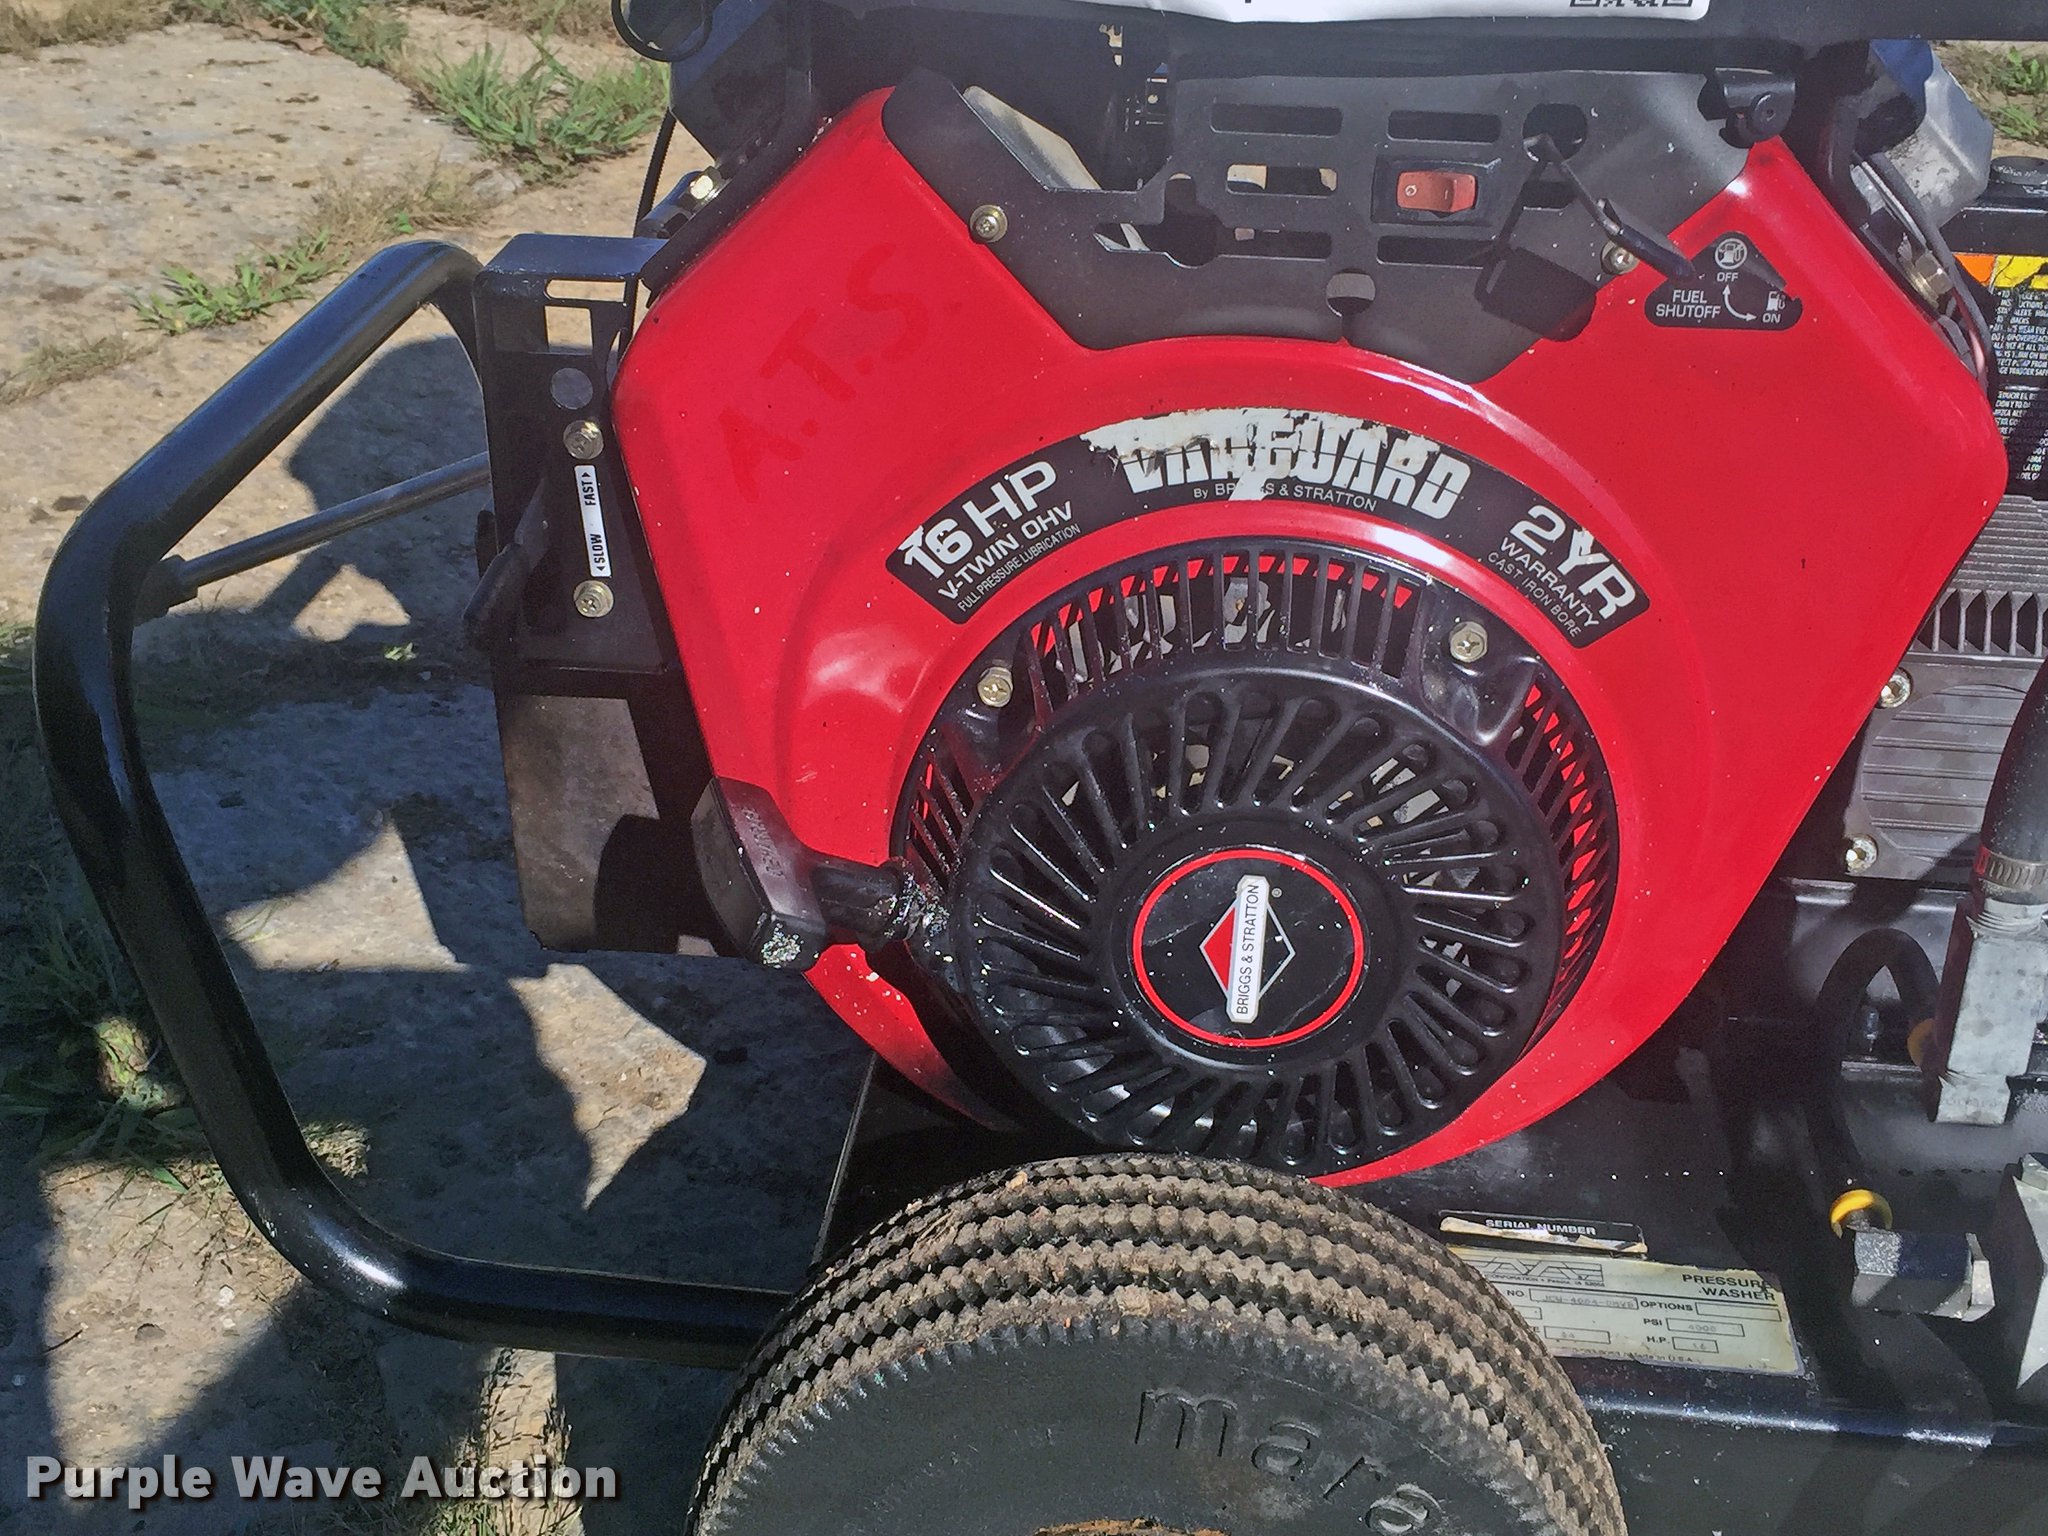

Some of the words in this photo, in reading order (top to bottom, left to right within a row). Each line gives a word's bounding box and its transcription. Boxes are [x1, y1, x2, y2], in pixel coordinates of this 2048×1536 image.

[1716, 272, 1739, 282] OFF
[1672, 289, 1708, 304] FUEL
[1655, 304, 1721, 319] SHUTOFF
[1762, 312, 1781, 323] ON
[581, 480, 597, 506] FAST
[1193, 488, 1208, 499] By
[1278, 484, 1289, 496] &
[1293, 485, 1377, 512] STRATTON
[903, 518, 974, 579] 16
[962, 461, 1057, 539] HP
[590, 533, 606, 564] SLOW
[937, 532, 1020, 600] V-TWIN
[1020, 500, 1073, 540] OHV
[957, 588, 981, 612] FULL
[978, 559, 1023, 596] PRESSURE
[1020, 523, 1081, 566] LUBRICATION
[1500, 537, 1599, 627] WARRANTY
[1488, 552, 1524, 579] CAST
[1521, 577, 1552, 606] IRON
[1550, 604, 1582, 638] BORE
[1242, 884, 1260, 952] STRATTON
[1244, 955, 1254, 965] &
[1236, 966, 1253, 1015] BRIGGS
[1485, 1219, 1531, 1229] SERIAL
[1537, 1223, 1597, 1236] NUMBER
[1682, 1274, 1772, 1289] PRESSURE
[1506, 1289, 1524, 1297] NO
[1640, 1300, 1694, 1312] OPTIONS
[1702, 1287, 1776, 1301] WASHER
[1643, 1318, 1663, 1326] PSI
